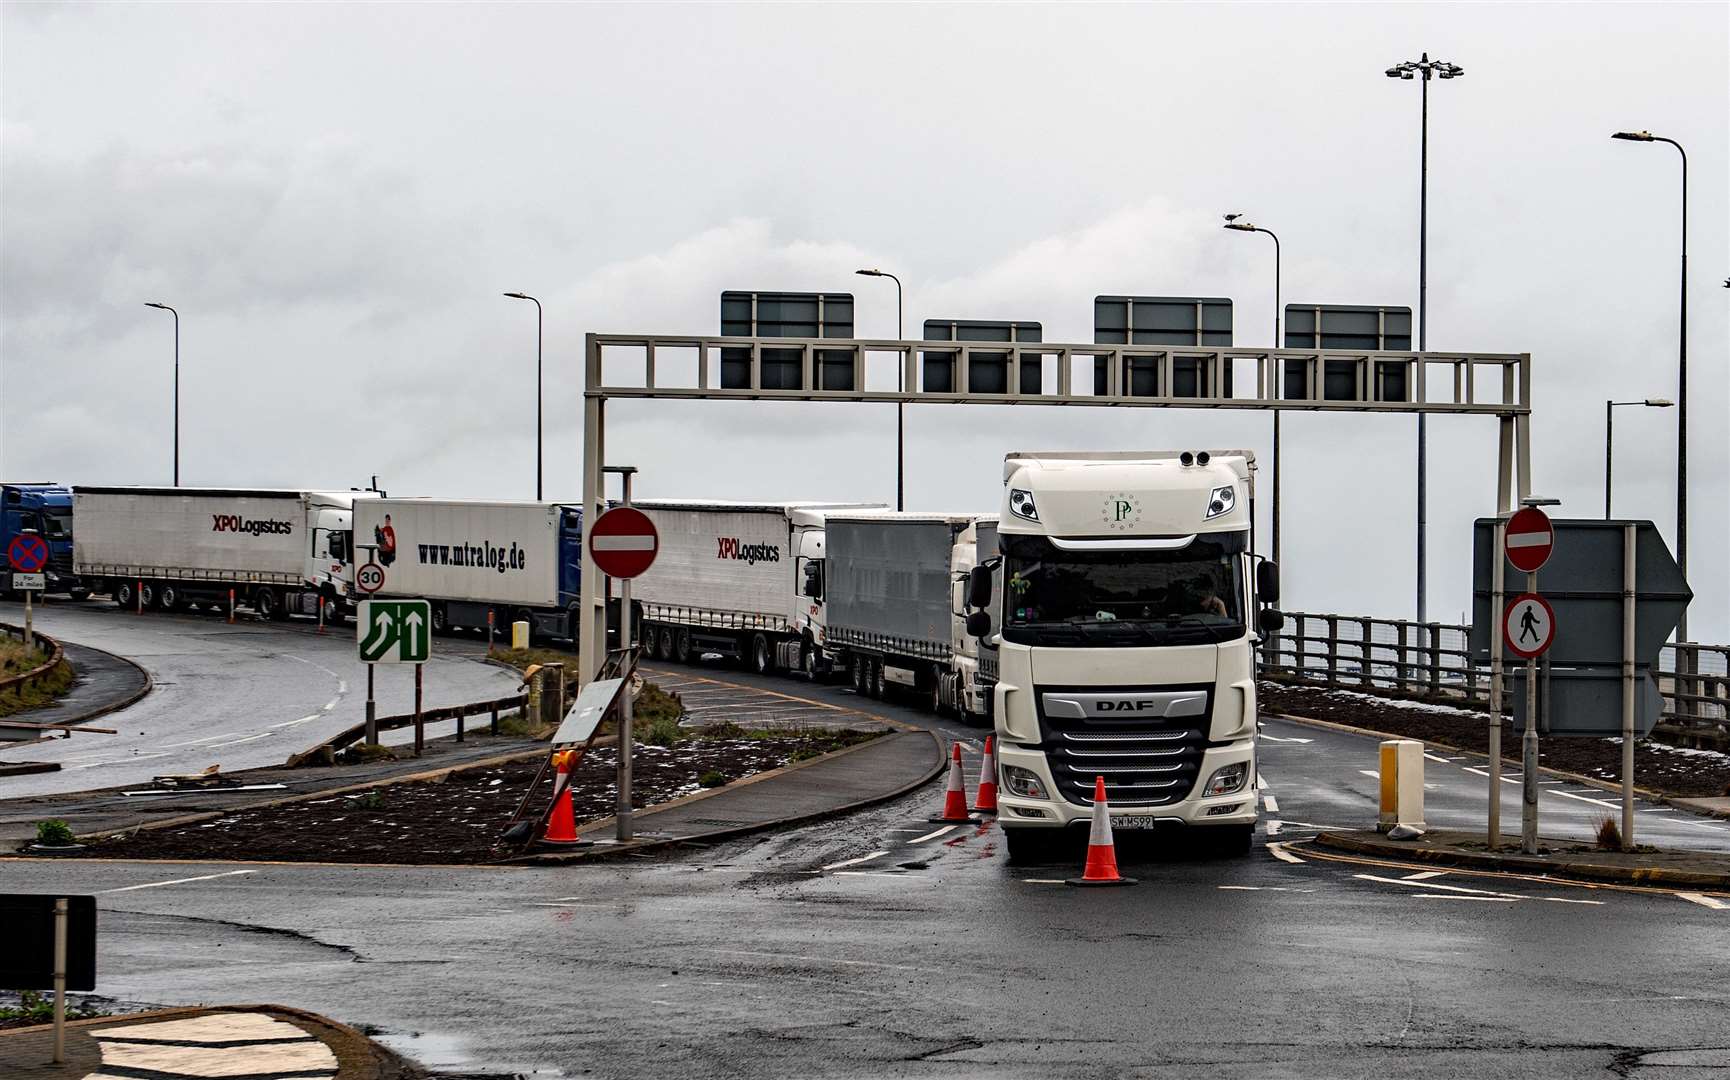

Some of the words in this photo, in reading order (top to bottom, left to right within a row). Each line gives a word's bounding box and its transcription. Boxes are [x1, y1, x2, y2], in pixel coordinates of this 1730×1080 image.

[418, 540, 525, 573] www.mtralog.de
[361, 571, 381, 584] 30
[1096, 700, 1154, 711] DAF
